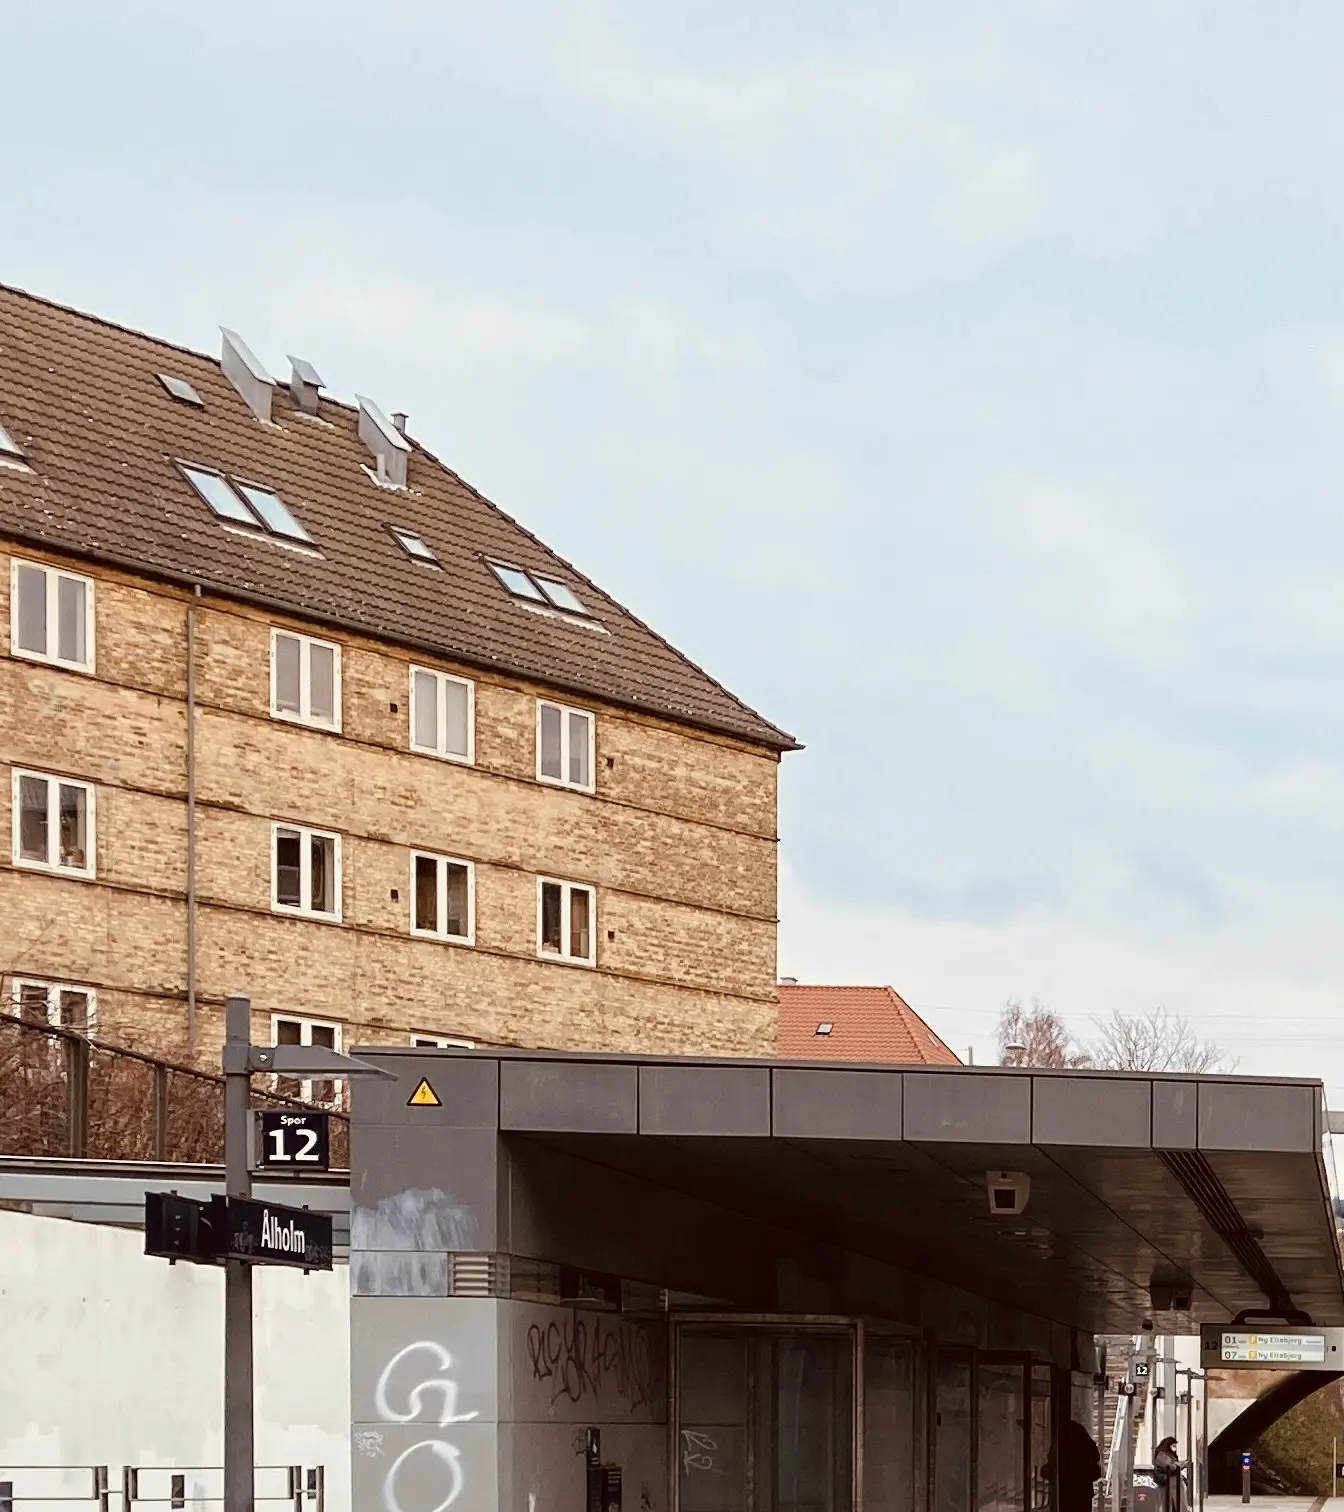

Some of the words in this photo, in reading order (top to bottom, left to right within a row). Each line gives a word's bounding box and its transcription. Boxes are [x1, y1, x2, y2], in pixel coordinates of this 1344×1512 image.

[280, 1115, 307, 1127] Spor
[268, 1129, 319, 1161] 12
[261, 1209, 305, 1254] Ålholm
[1224, 1351, 1237, 1360] 07
[1136, 1366, 1148, 1375] 12
